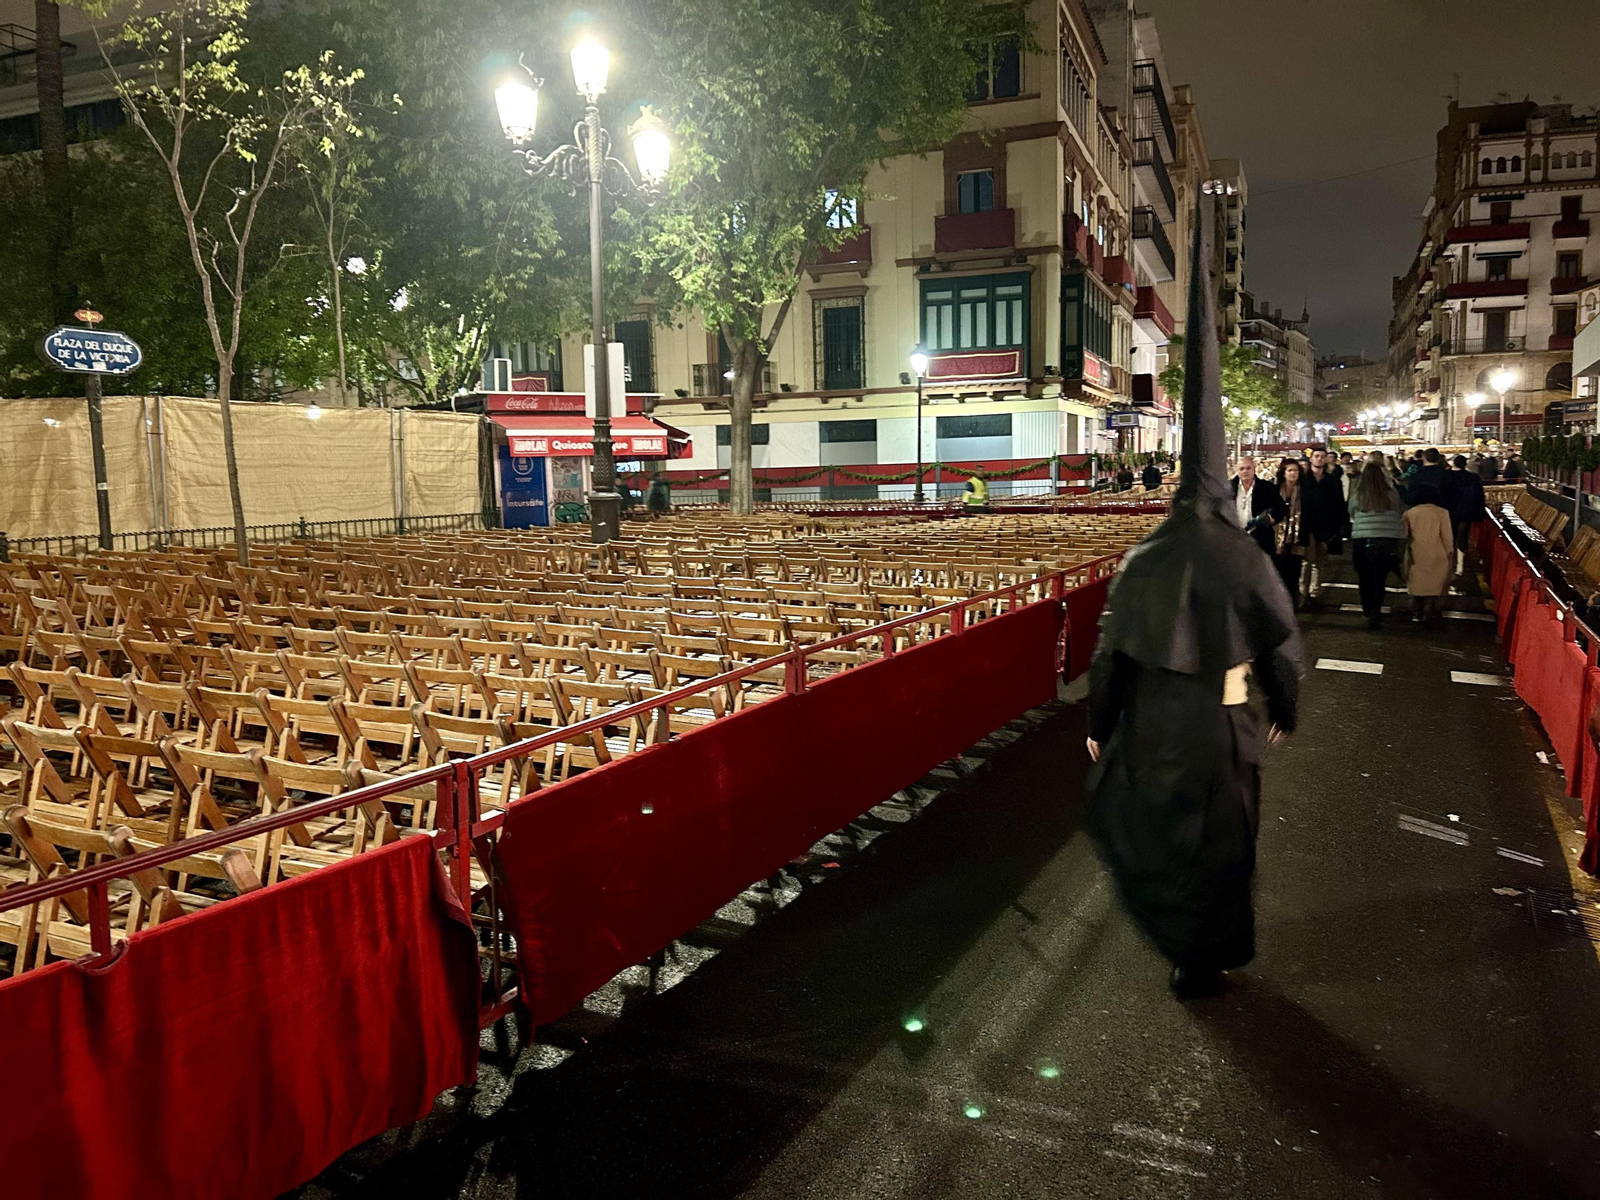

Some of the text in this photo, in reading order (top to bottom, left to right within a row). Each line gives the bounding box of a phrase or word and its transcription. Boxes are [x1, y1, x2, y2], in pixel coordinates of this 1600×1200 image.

[54, 338, 133, 354] PLAZA DEL DUQUE
[58, 349, 131, 363] DE LA VICTORIA
[552, 440, 594, 450] Quiosco
